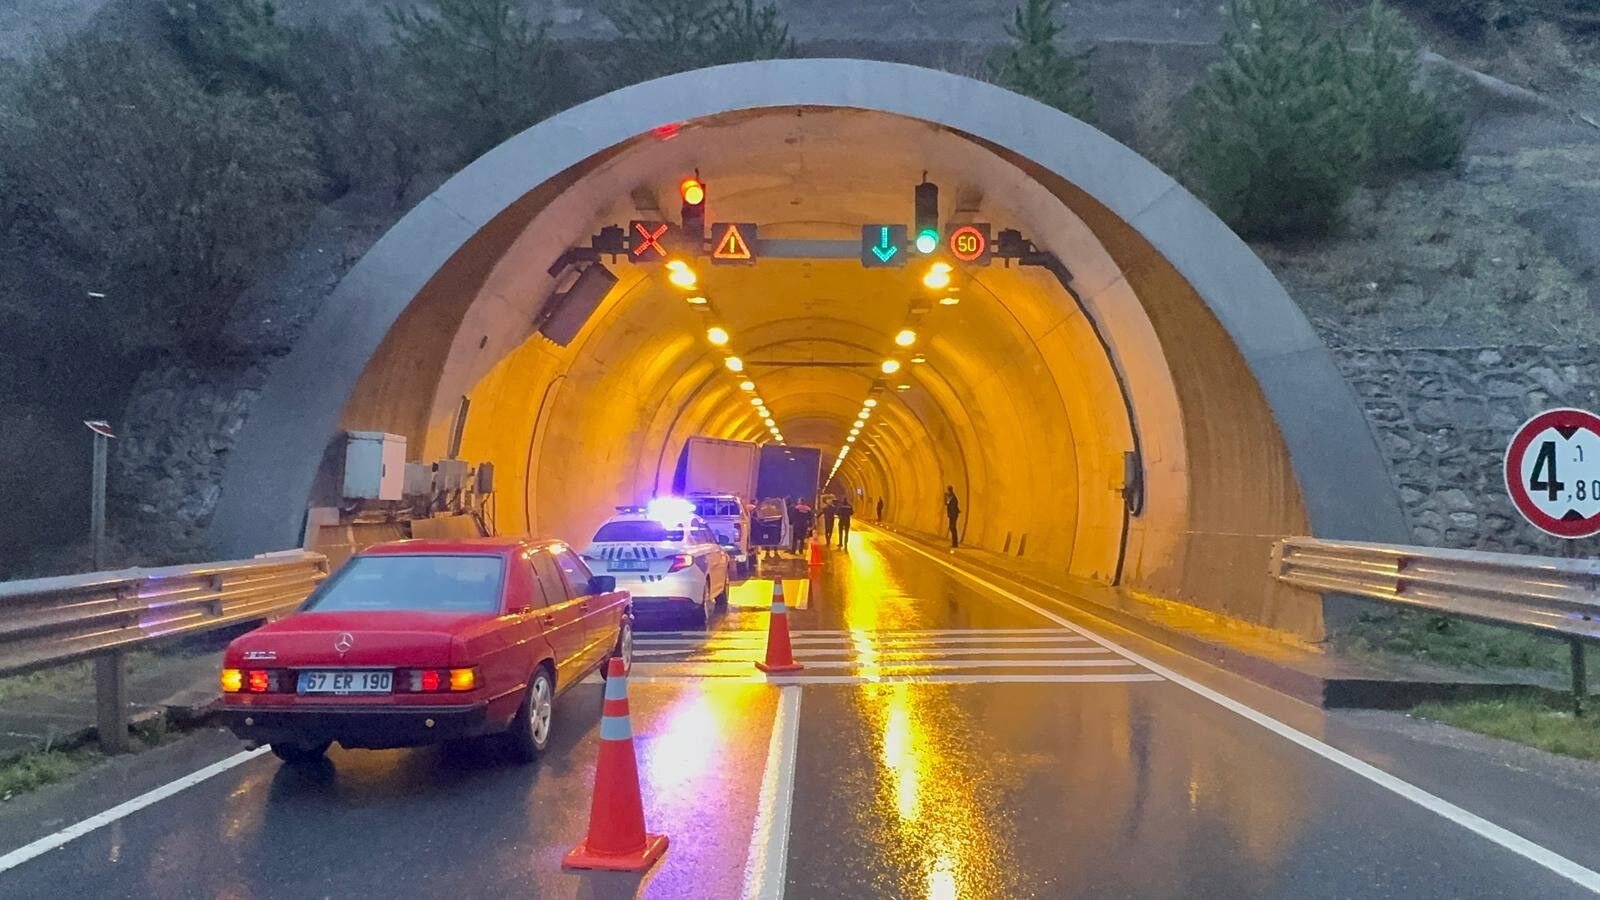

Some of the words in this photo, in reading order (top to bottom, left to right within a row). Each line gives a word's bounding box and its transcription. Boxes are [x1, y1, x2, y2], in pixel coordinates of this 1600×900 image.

[958, 236, 977, 252] 50
[307, 674, 327, 690] 67
[333, 674, 354, 690] ER
[362, 674, 390, 690] 190
